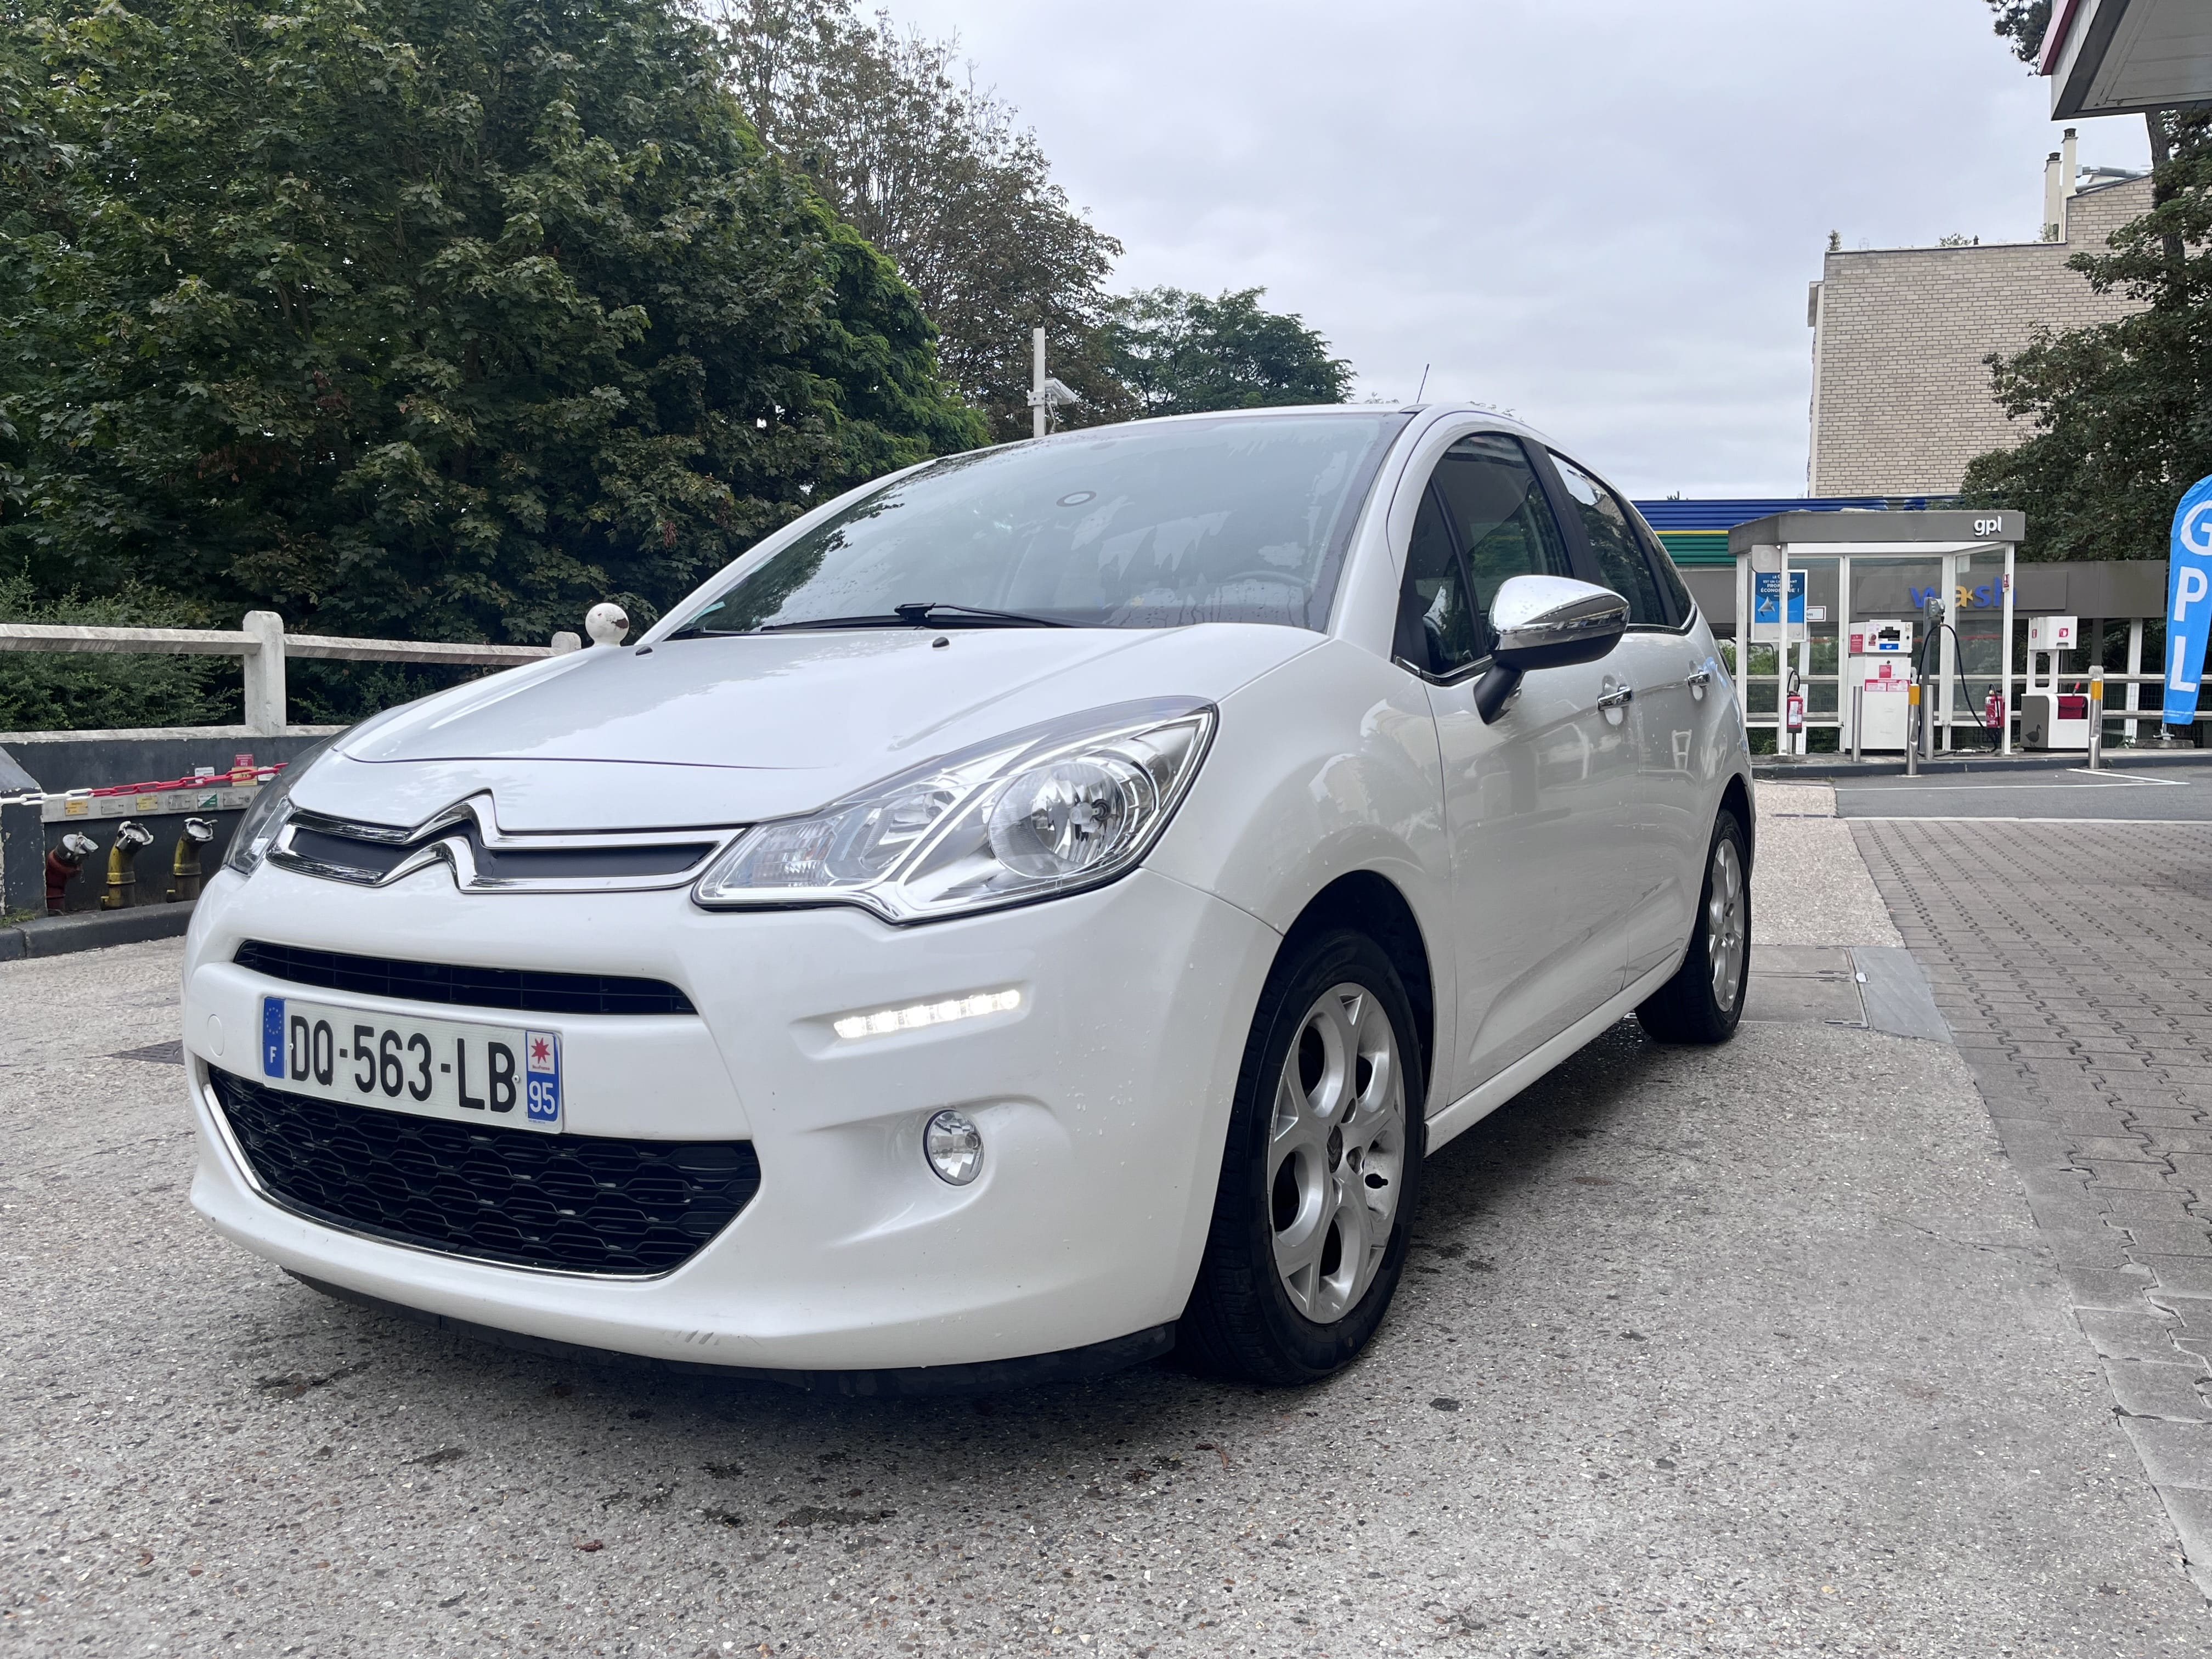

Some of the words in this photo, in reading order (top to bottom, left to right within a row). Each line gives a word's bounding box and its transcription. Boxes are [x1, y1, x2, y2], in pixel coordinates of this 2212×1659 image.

[1974, 516, 2001, 536] gpl
[1760, 550, 1772, 567] 9
[2169, 500, 2212, 692] GPL
[269, 1046, 277, 1064] F
[291, 1014, 517, 1113] DQ-563-LB
[529, 1080, 556, 1115] 95
